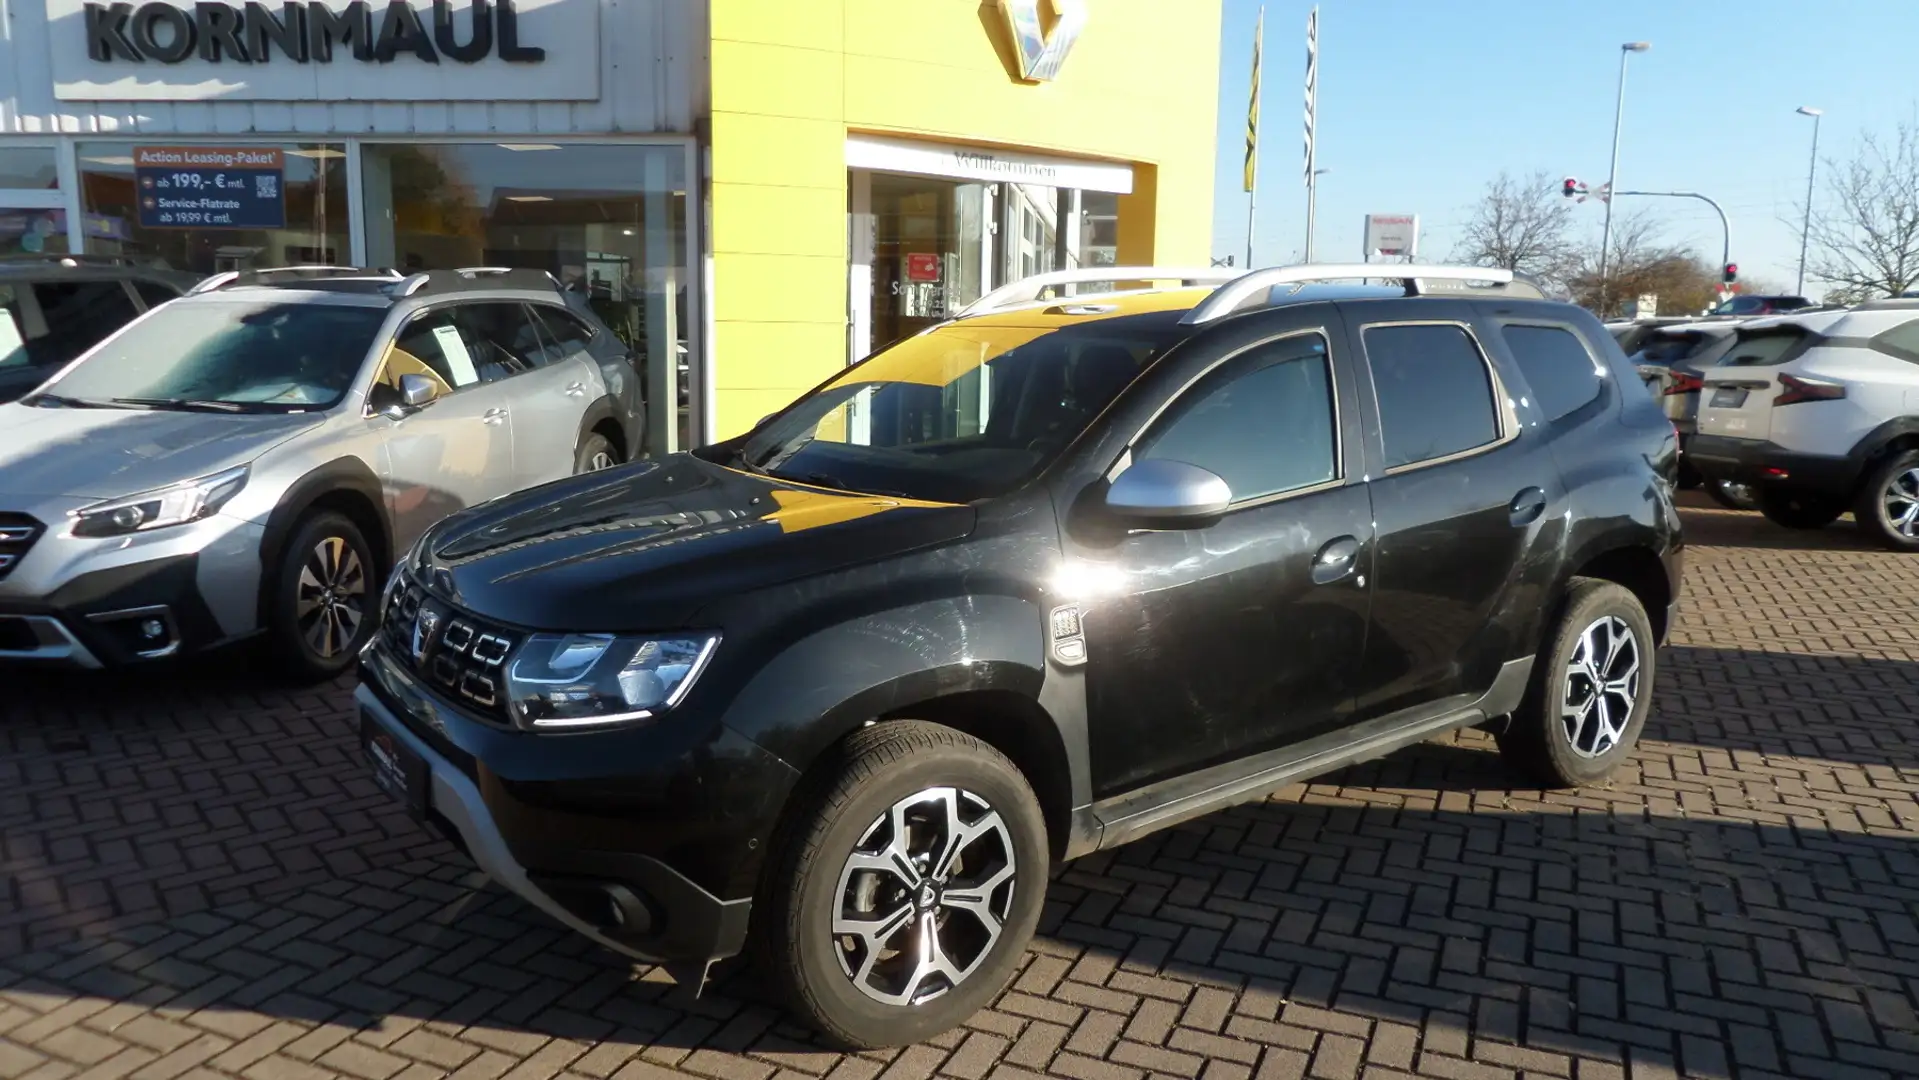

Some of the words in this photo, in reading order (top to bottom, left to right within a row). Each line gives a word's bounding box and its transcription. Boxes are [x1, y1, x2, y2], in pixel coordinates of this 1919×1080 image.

[84, 0, 545, 64] KORNMAUL
[140, 151, 181, 163] Action
[953, 151, 1056, 177] Willkommen
[156, 177, 171, 189] ab
[172, 173, 211, 190] 199,-
[215, 173, 226, 189] €
[158, 198, 240, 209] Service-Flatrate
[160, 213, 173, 223] ab
[175, 212, 201, 223] 19,99
[203, 213, 212, 224] €
